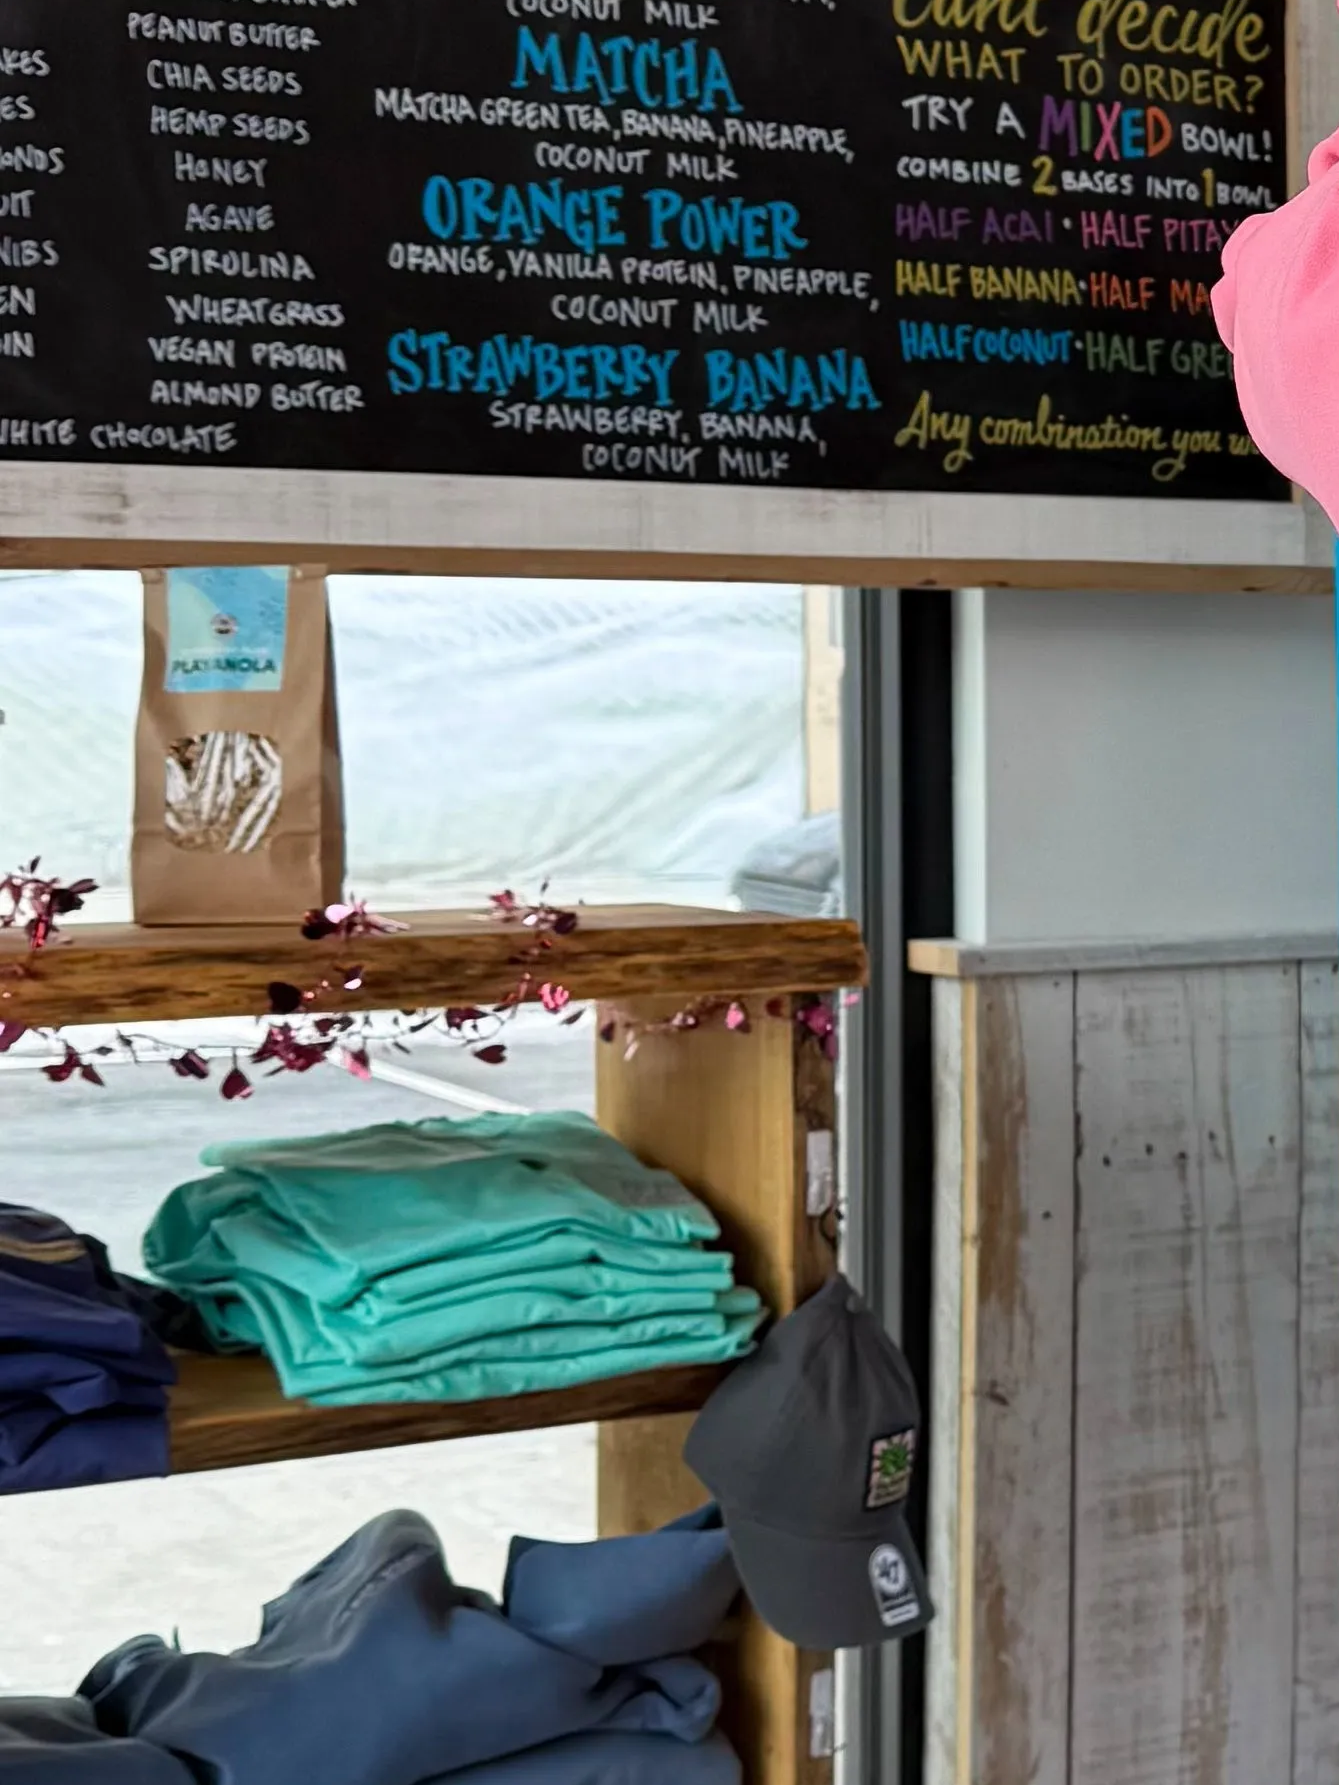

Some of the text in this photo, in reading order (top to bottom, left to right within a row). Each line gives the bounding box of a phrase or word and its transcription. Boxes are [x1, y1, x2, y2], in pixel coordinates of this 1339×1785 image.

[127, 12, 321, 51] PEANUT BUTTER
[146, 59, 303, 96] CHIA SEEDS
[511, 25, 743, 113] MATCHA
[895, 35, 1264, 114] WHAT TO ORDER?
[150, 104, 310, 145] HEMP SEEDS
[901, 94, 1272, 162] TRY A MIXED BOWL!
[174, 150, 267, 187] HONEY
[896, 156, 1021, 187] COMBINE
[1032, 155, 1058, 196] 2
[1061, 170, 1133, 195] BASES
[1146, 175, 1200, 201] INTO
[1215, 181, 1278, 210] BOWL
[185, 202, 274, 232] AGAVE
[422, 175, 808, 270] ORANGE POWER
[896, 202, 972, 244] HALF
[981, 208, 1053, 243] ACAI
[1081, 211, 1150, 249] HALF
[148, 246, 315, 281] SPIRULINA
[895, 259, 961, 298] HALF
[969, 265, 1082, 306] BANANA
[1089, 271, 1155, 311] HALF
[551, 294, 768, 335] COCONUT MILK
[147, 335, 346, 372] VEGAN PROTEIN
[899, 319, 1165, 375] HALF COCONUT HALF
[387, 328, 881, 413] STRAWBERRY BANANA
[150, 379, 364, 412] ALMOND BUTTER
[89, 421, 237, 453] CHOCOLATE
[894, 389, 973, 473] Any
[979, 393, 1167, 451] combination
[1154, 426, 1222, 482] you
